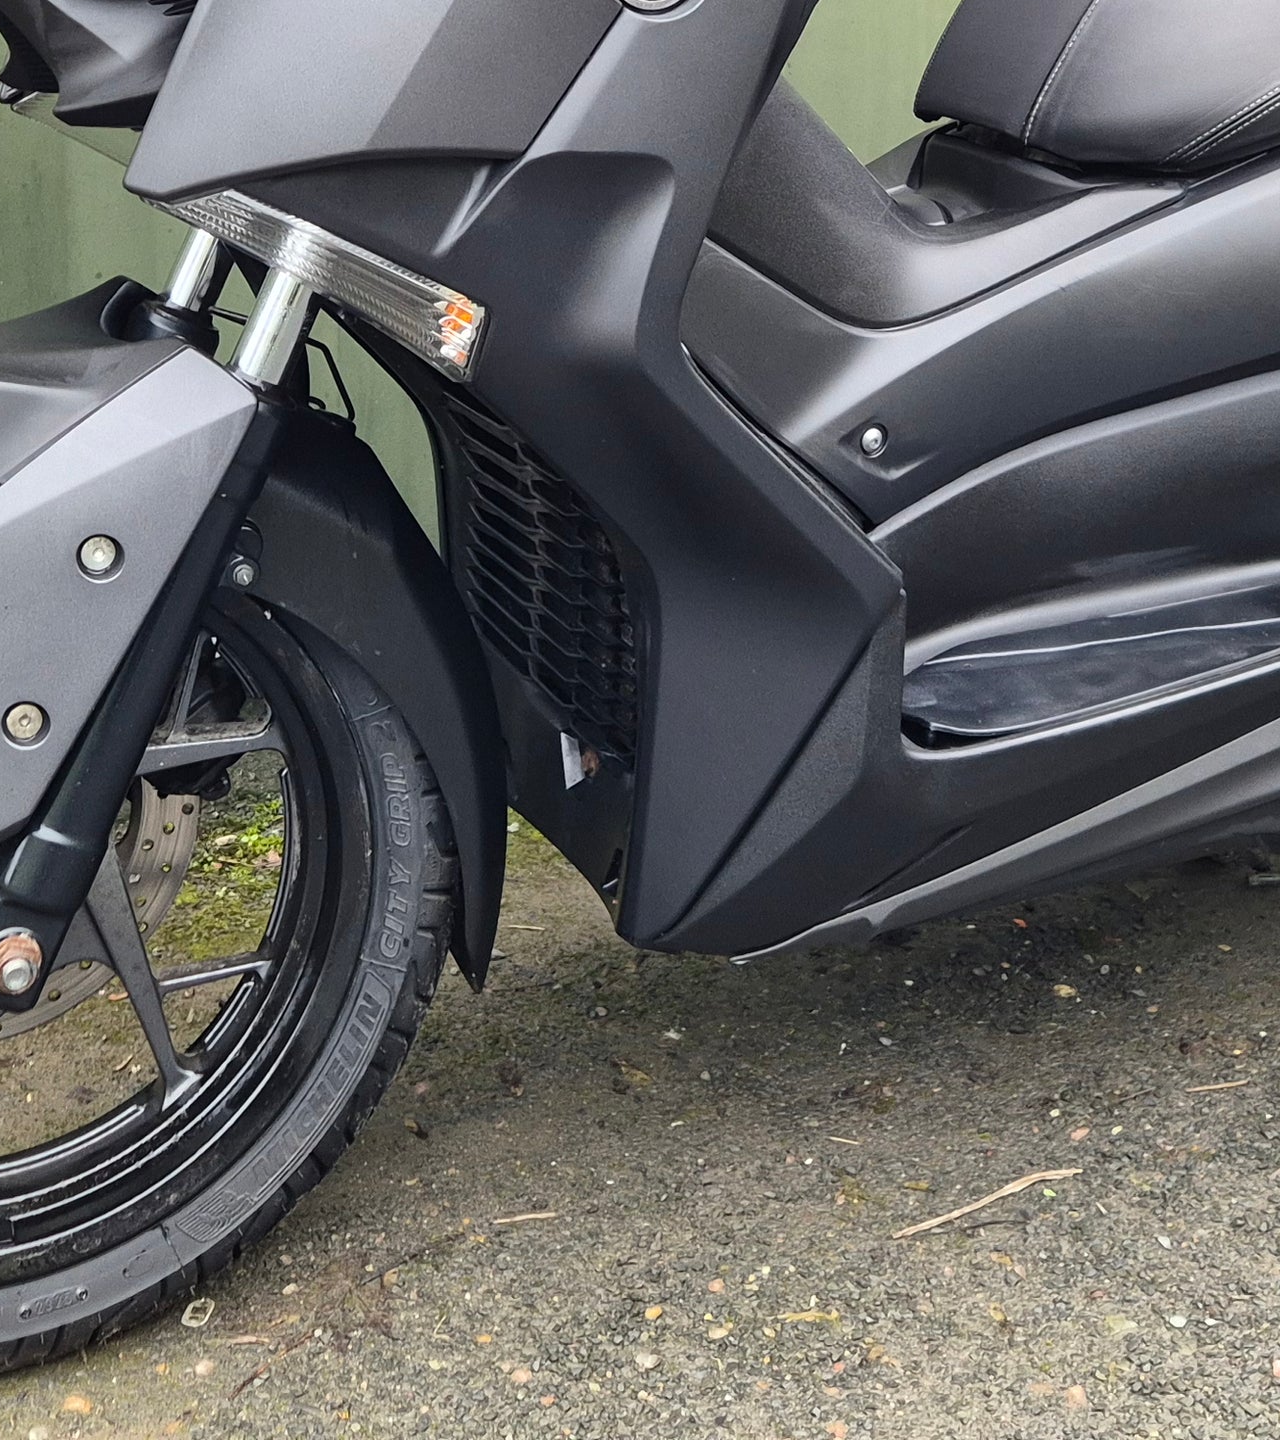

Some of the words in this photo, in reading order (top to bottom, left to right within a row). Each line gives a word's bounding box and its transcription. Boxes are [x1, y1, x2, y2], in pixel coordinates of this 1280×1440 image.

[381, 749, 415, 848] GRIP
[378, 860, 414, 961] CITY
[248, 991, 387, 1184] MICHELIN
